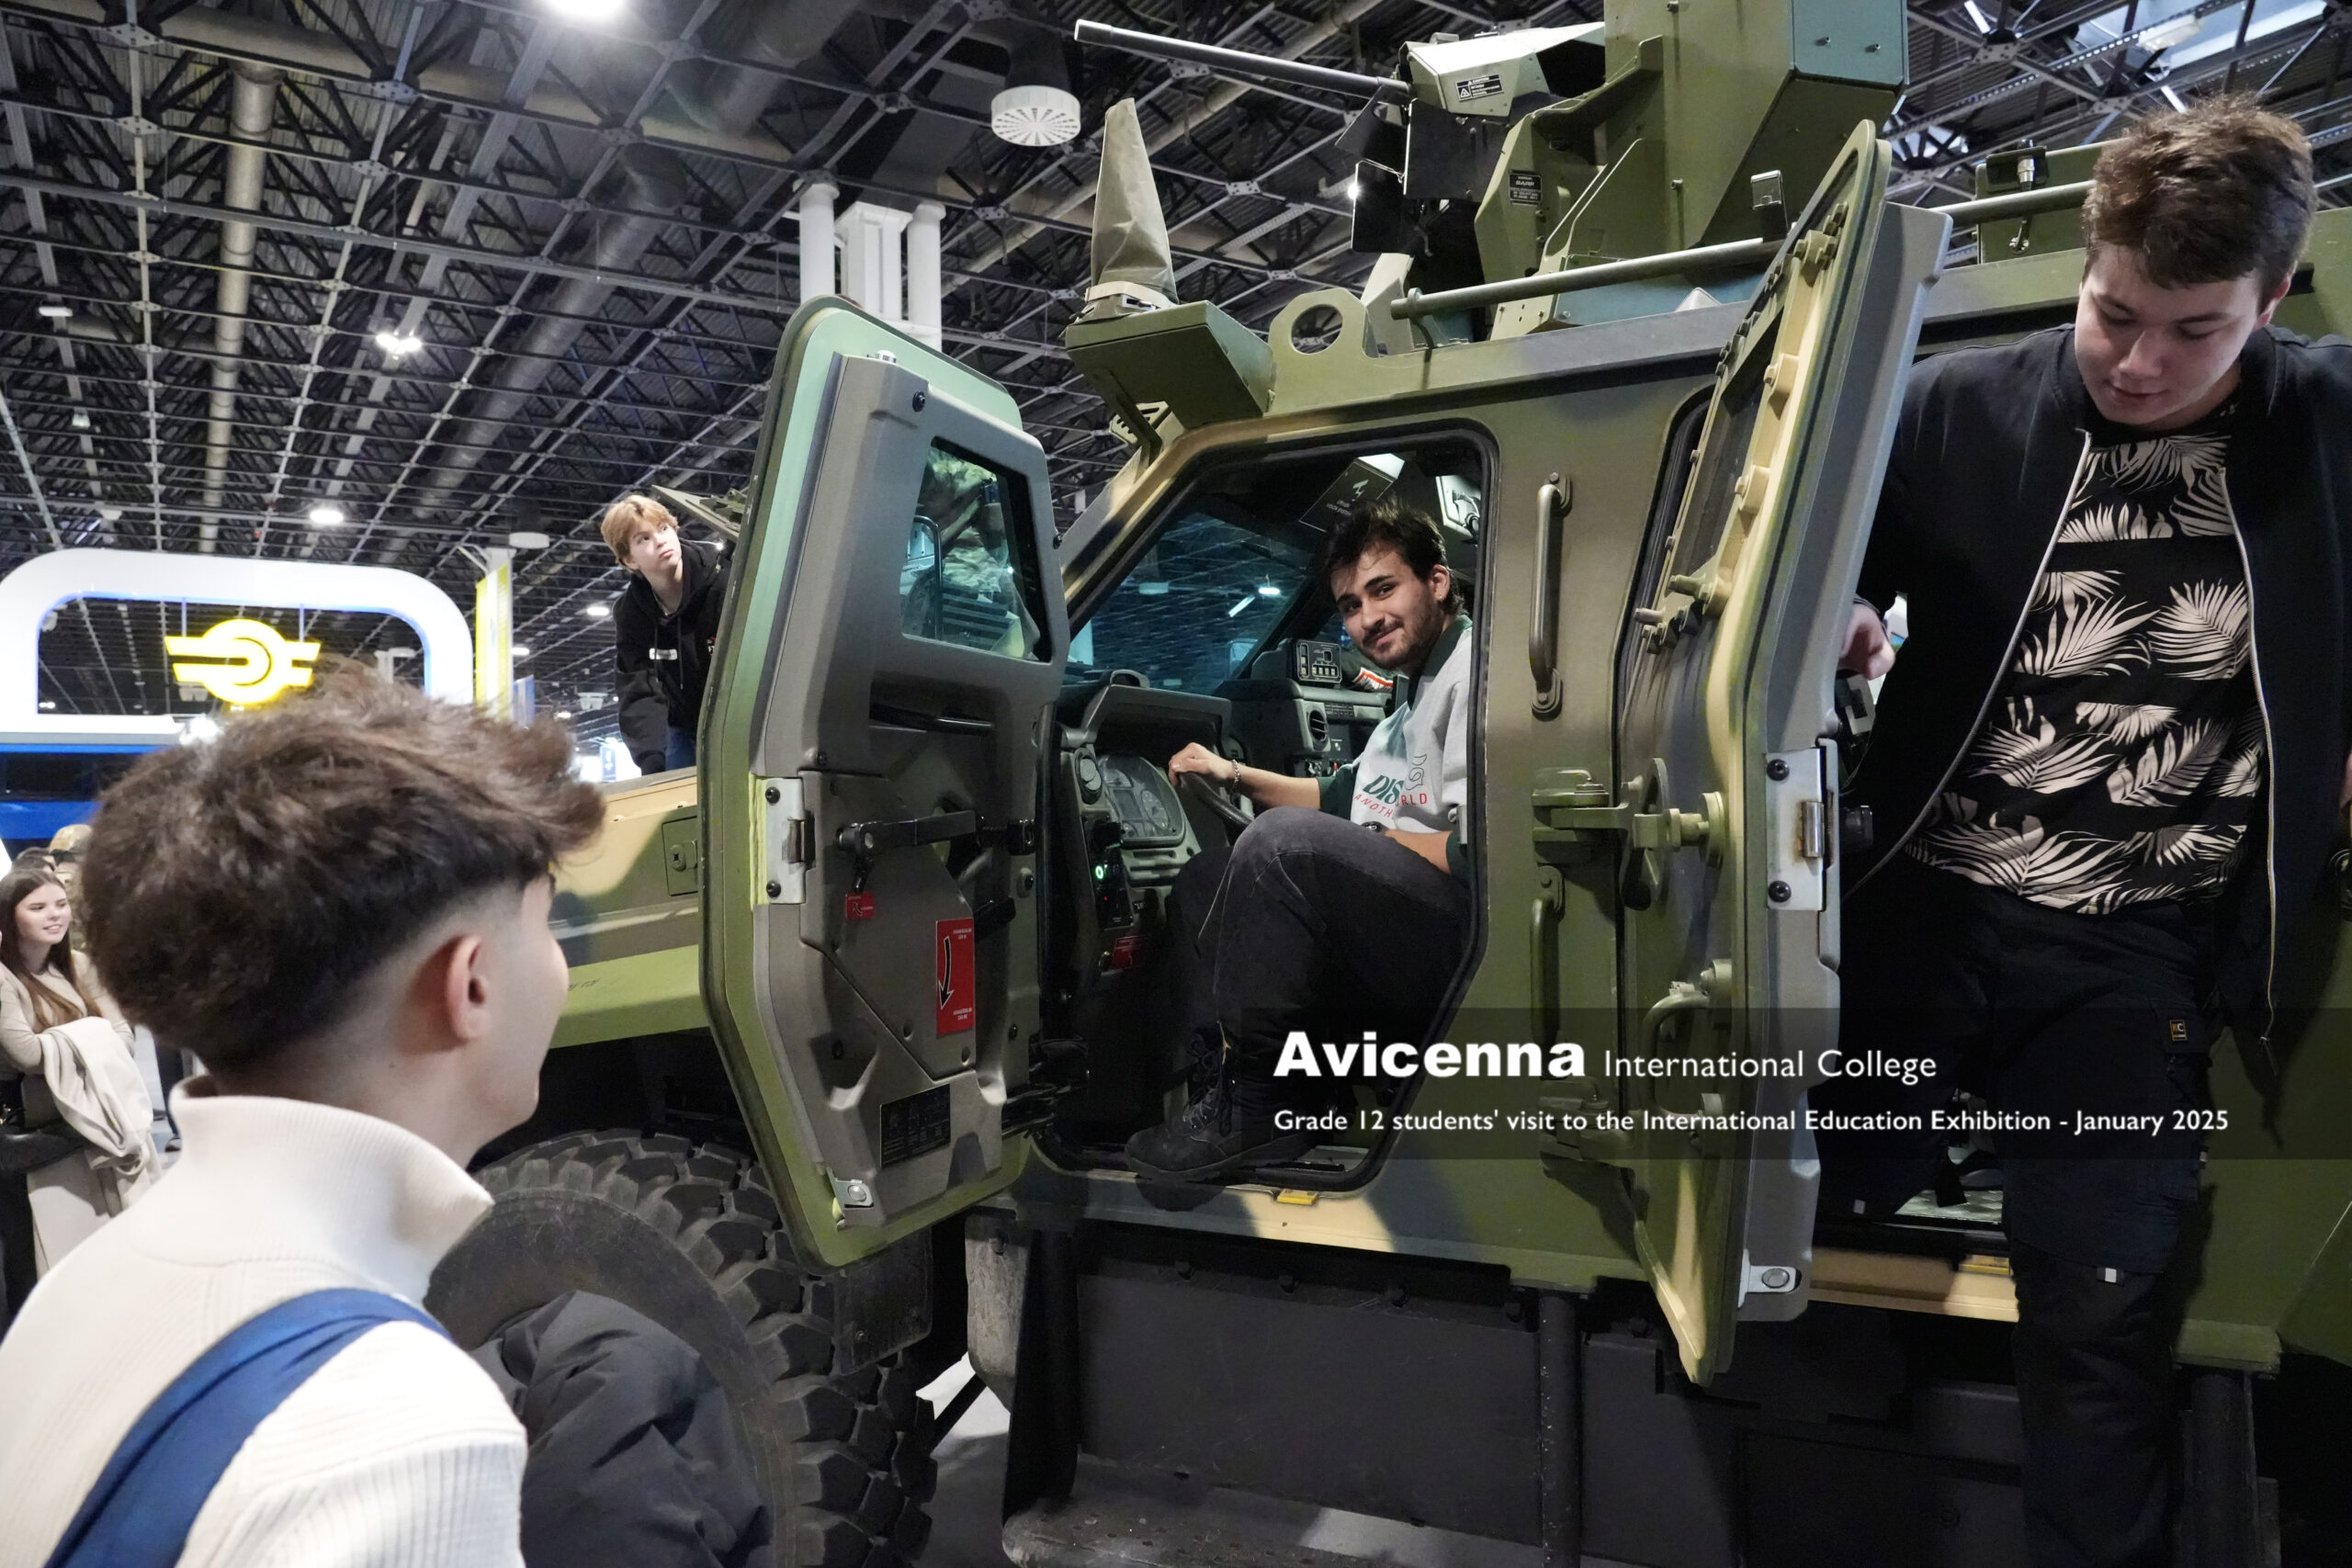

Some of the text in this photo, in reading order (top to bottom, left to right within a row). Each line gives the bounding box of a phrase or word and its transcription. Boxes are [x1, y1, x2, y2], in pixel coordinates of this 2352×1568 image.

[1363, 774, 1405, 805] DIS
[1354, 793, 1428, 818] ANOTH RLD
